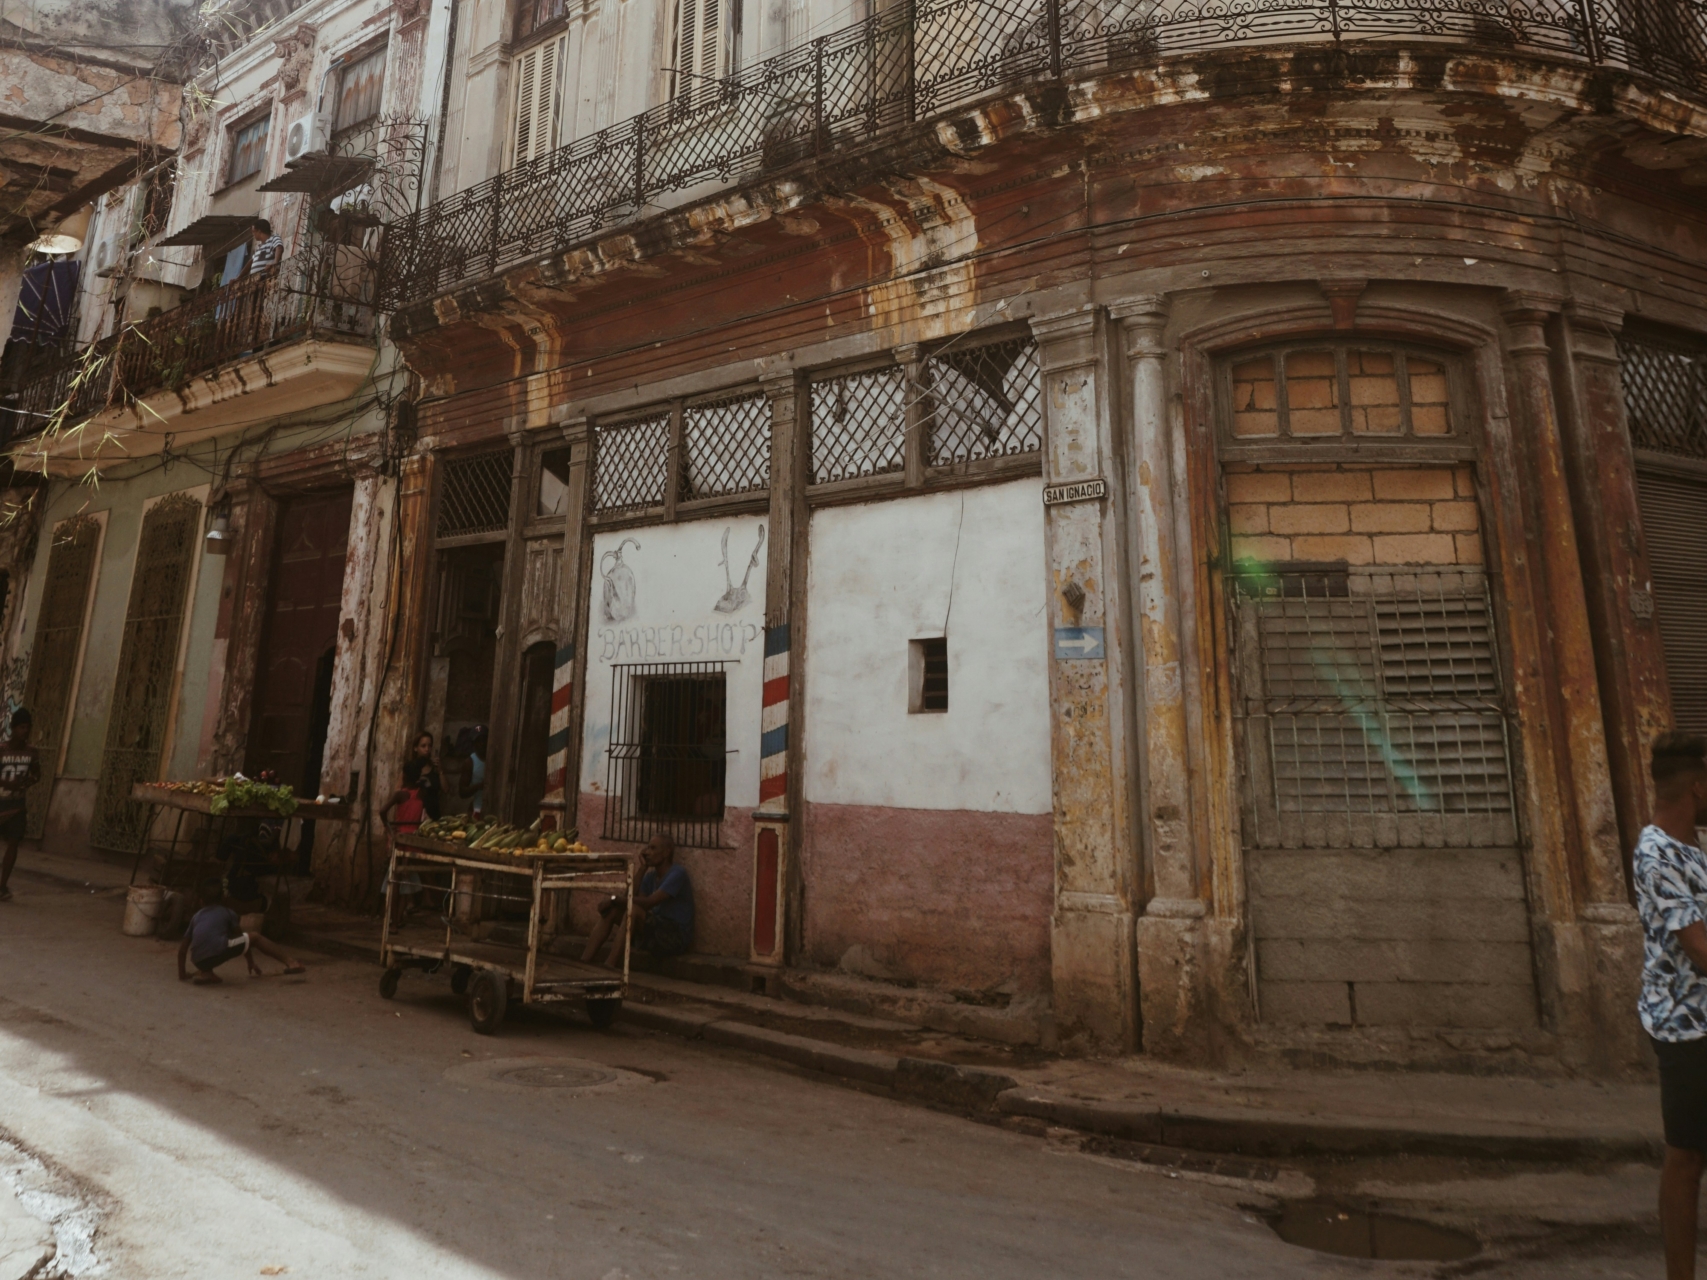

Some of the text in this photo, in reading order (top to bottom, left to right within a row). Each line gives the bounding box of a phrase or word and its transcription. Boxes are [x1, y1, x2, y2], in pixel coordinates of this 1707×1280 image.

[1046, 482, 1102, 503] SAN IGNACIO
[598, 620, 757, 663] BARBER SHOP
[2, 755, 31, 764] MIAMI
